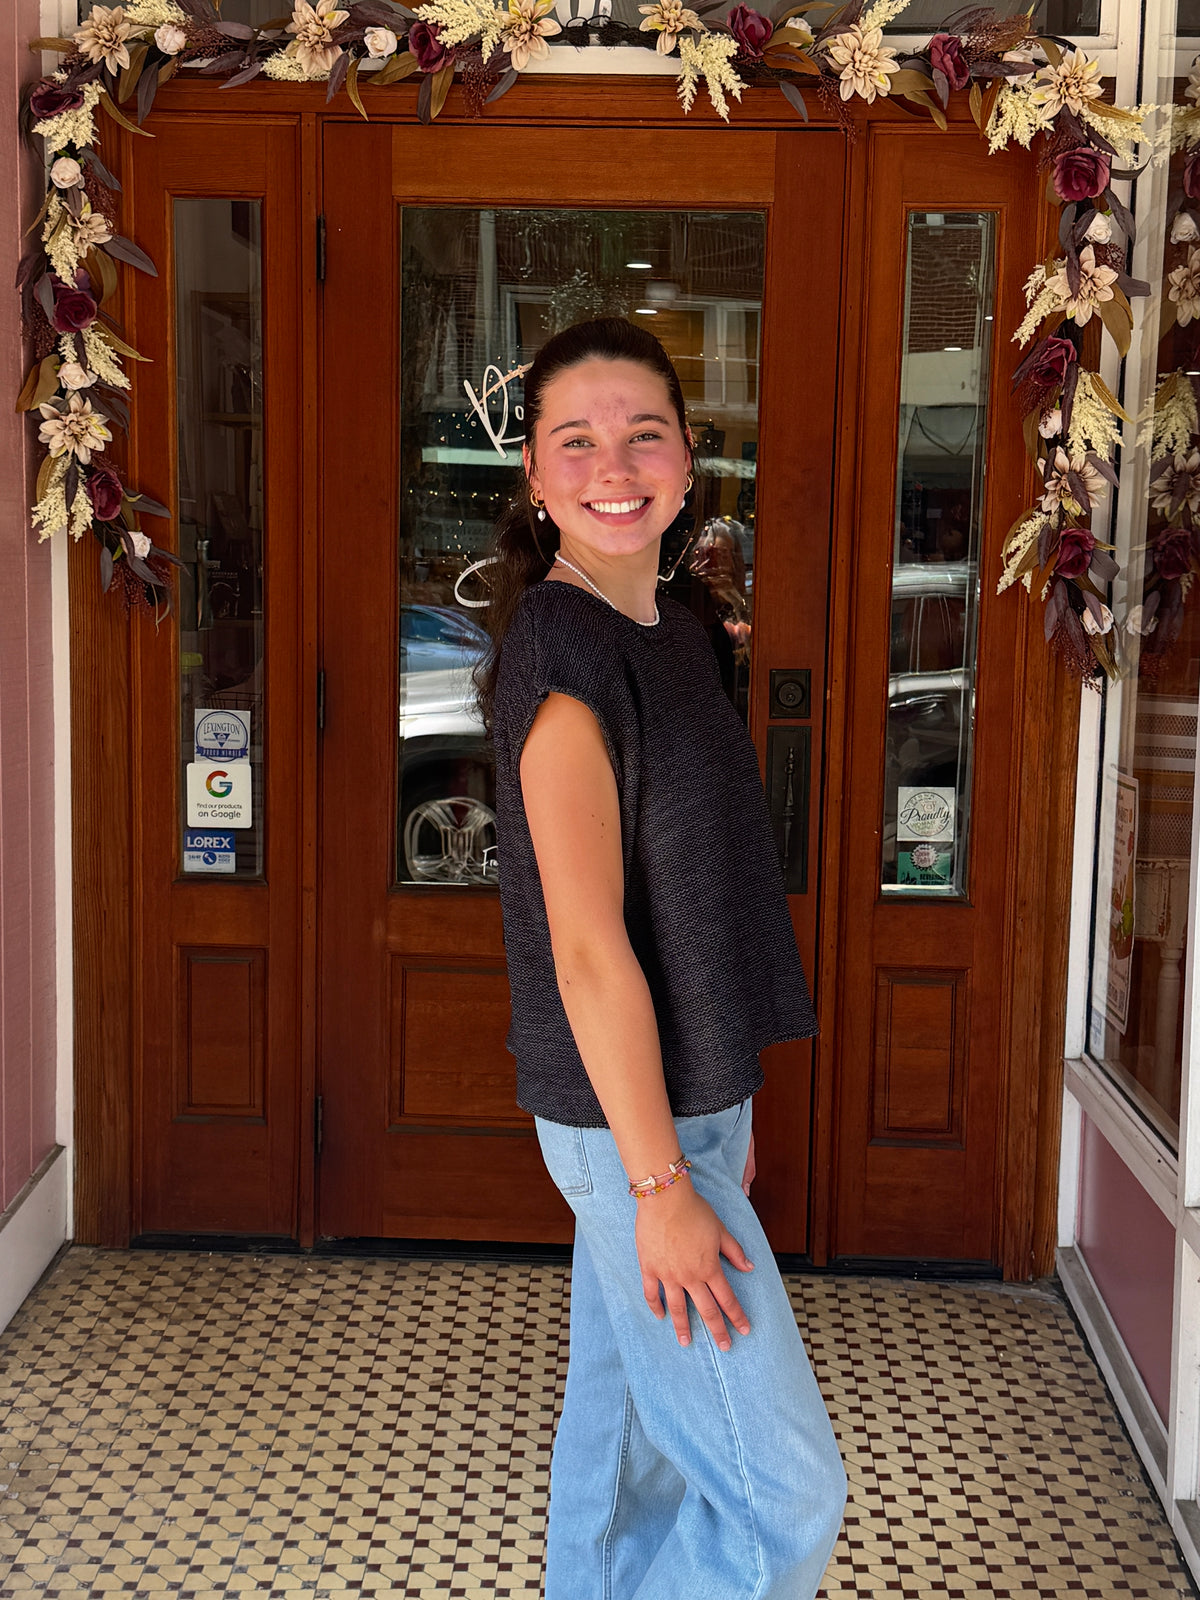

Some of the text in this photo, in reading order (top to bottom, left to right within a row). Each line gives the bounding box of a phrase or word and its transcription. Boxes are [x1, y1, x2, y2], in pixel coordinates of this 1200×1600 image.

[203, 723, 240, 735] LEXINGTON
[211, 810, 241, 819] Google
[900, 807, 950, 825] Proudly
[186, 836, 232, 849] LOREX
